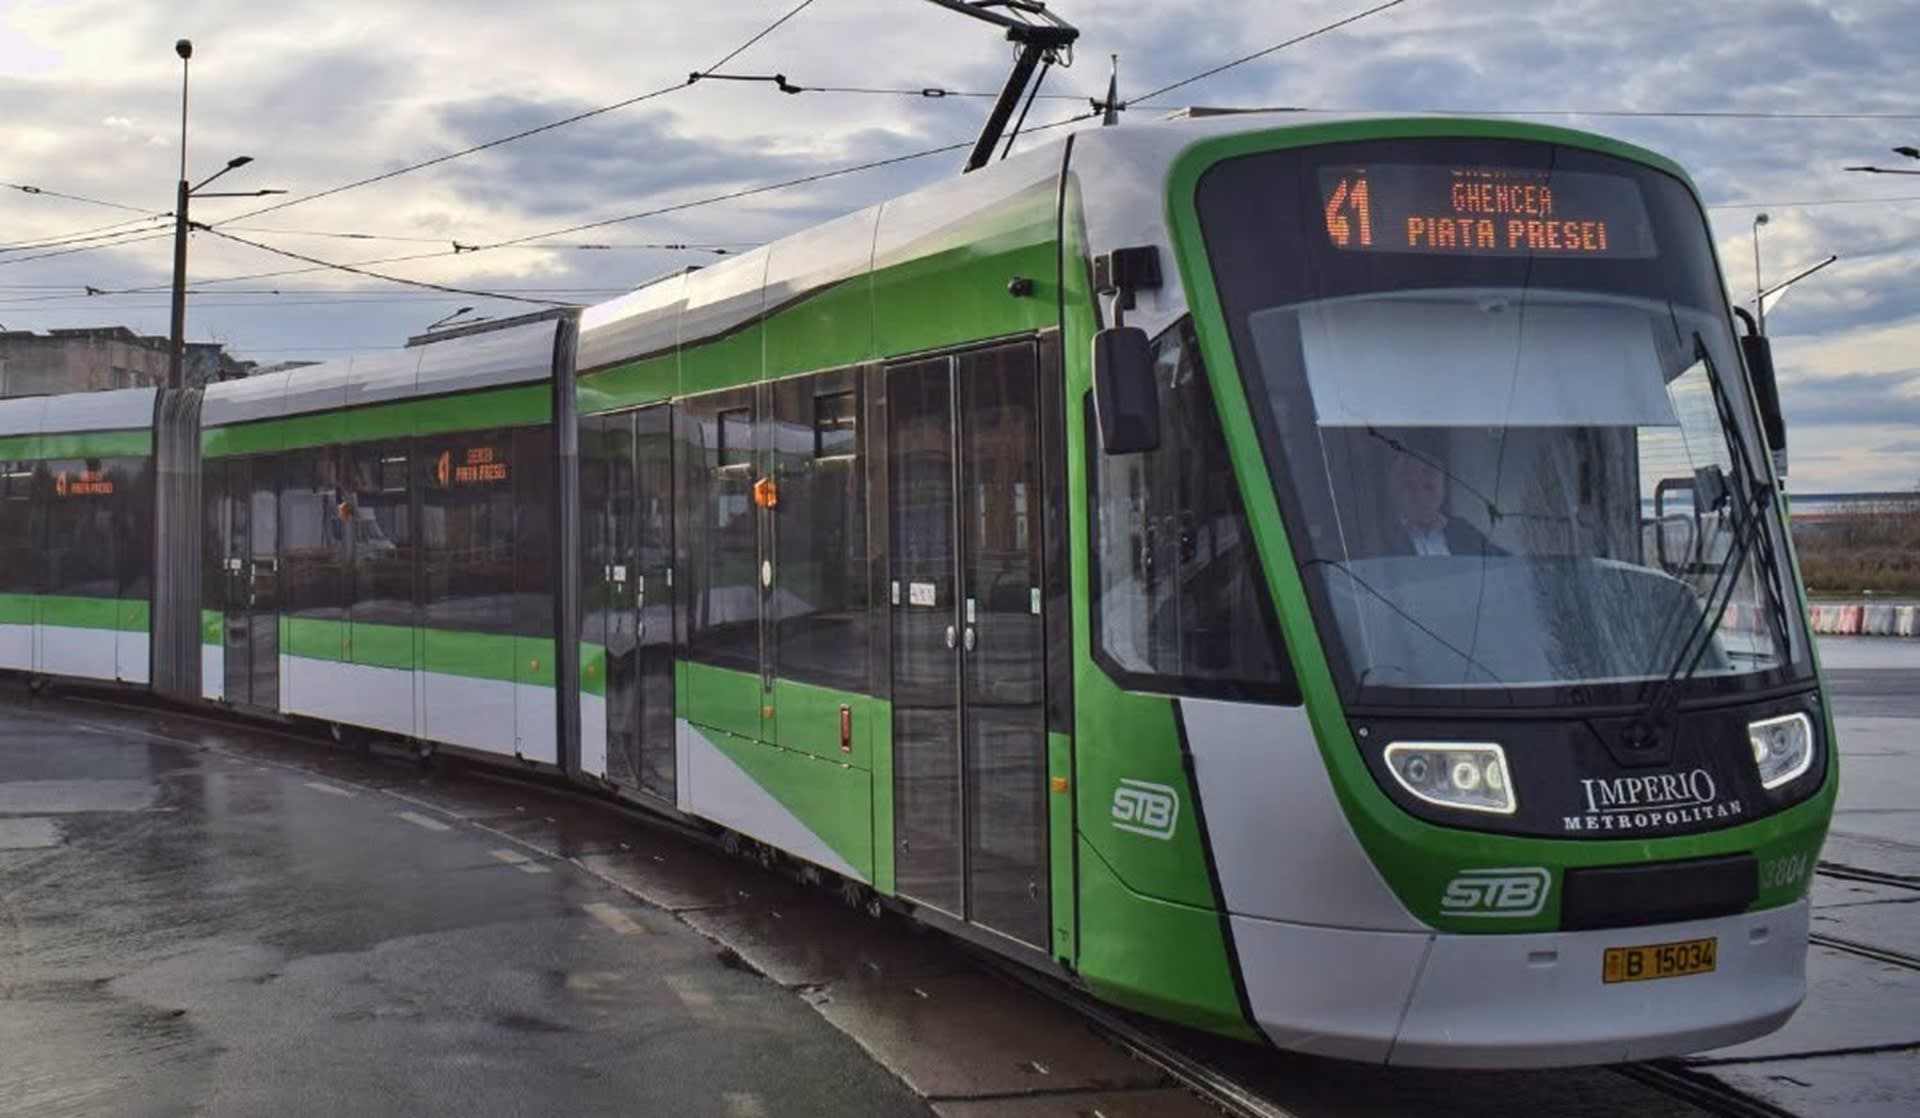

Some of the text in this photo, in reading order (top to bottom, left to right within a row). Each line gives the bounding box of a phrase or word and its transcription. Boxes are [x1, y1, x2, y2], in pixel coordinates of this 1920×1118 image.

[1452, 183, 1552, 214] GHENCEA
[1407, 217, 1607, 250] PIATA PRESEI
[1112, 786, 1172, 828] STB
[1580, 769, 1716, 813] IMPERIO
[1563, 800, 1742, 831] METROPOLITAN
[1440, 875, 1542, 909] STB
[1627, 941, 1713, 976] B 15034
